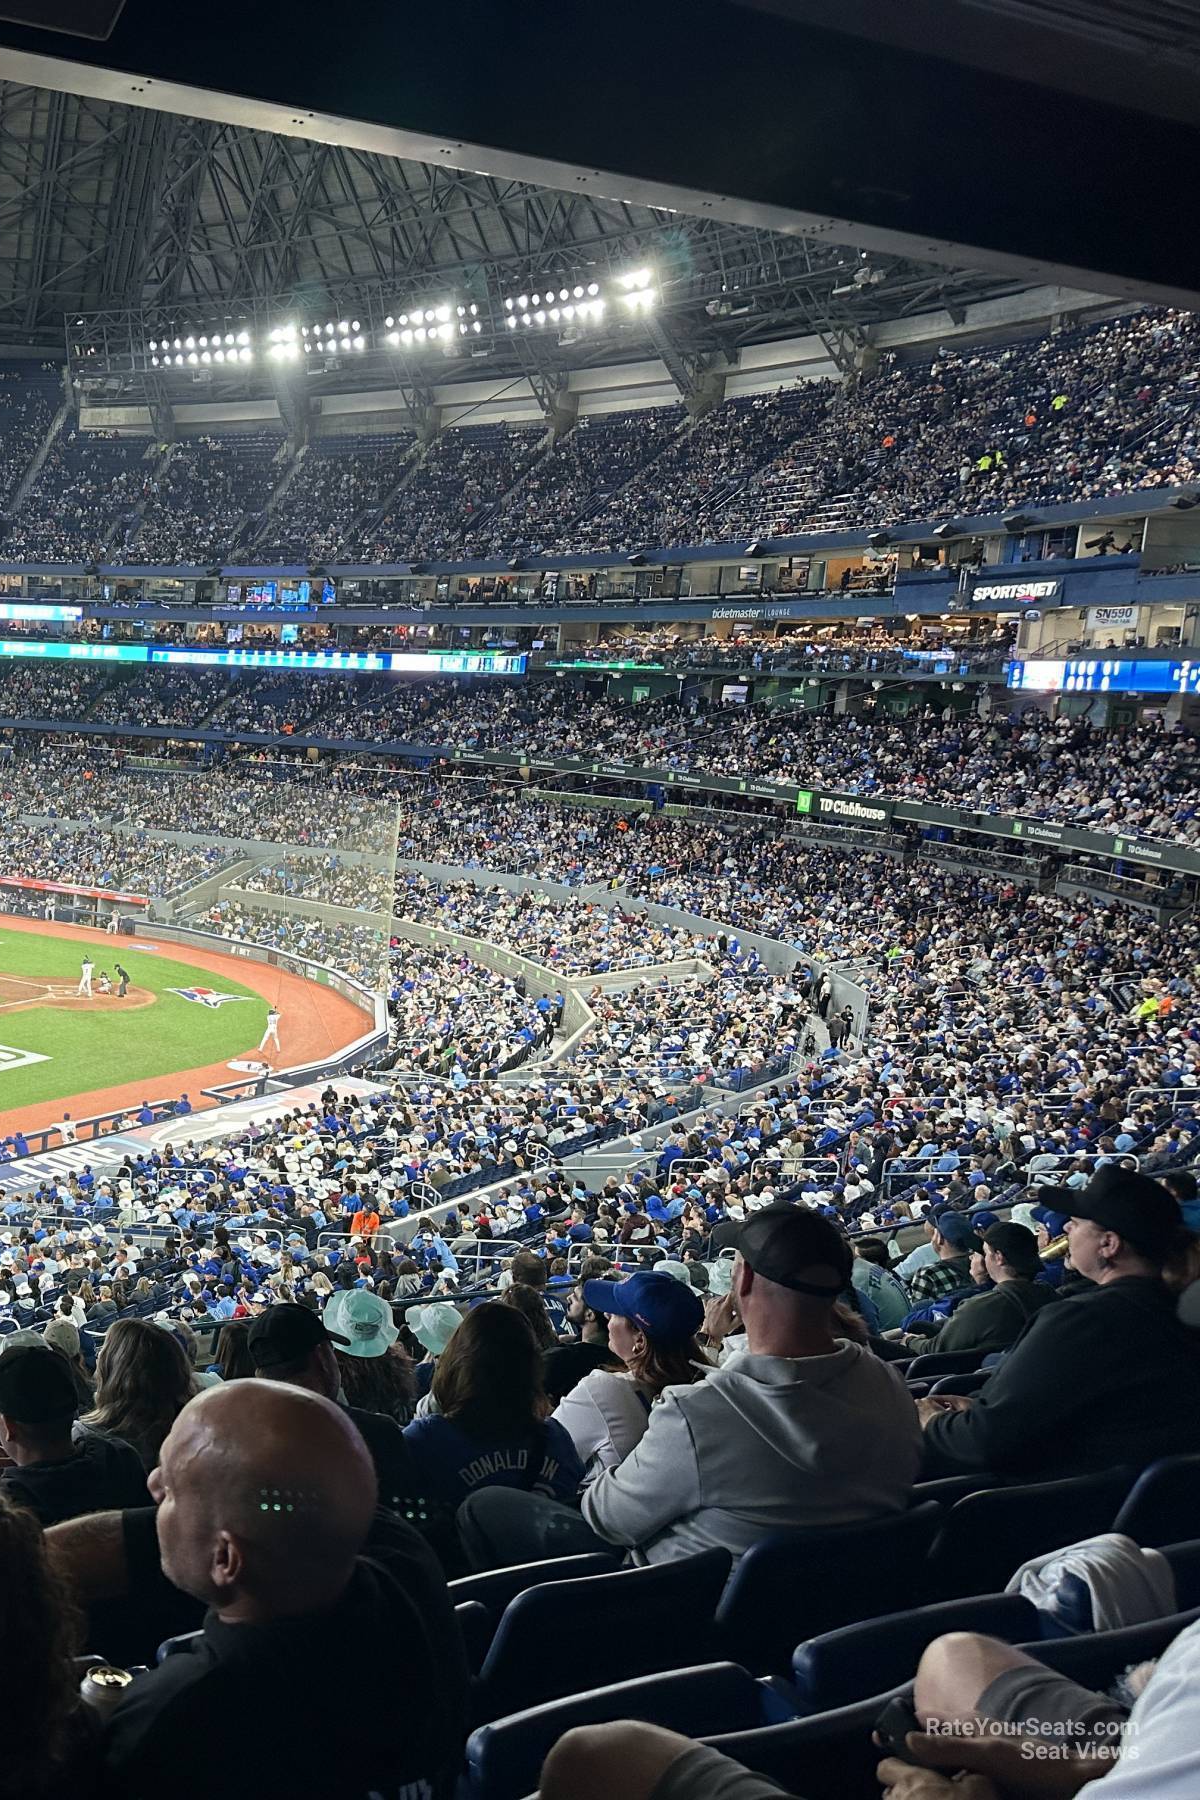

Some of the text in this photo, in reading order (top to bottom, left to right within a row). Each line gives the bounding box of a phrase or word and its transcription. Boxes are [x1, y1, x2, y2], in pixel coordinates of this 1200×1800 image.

[972, 582, 1057, 601] SPORTSNET
[712, 608, 792, 619] ticketmaster LOUNGE
[1095, 607, 1133, 619] SN590
[820, 798, 886, 821] TD Clubhouse
